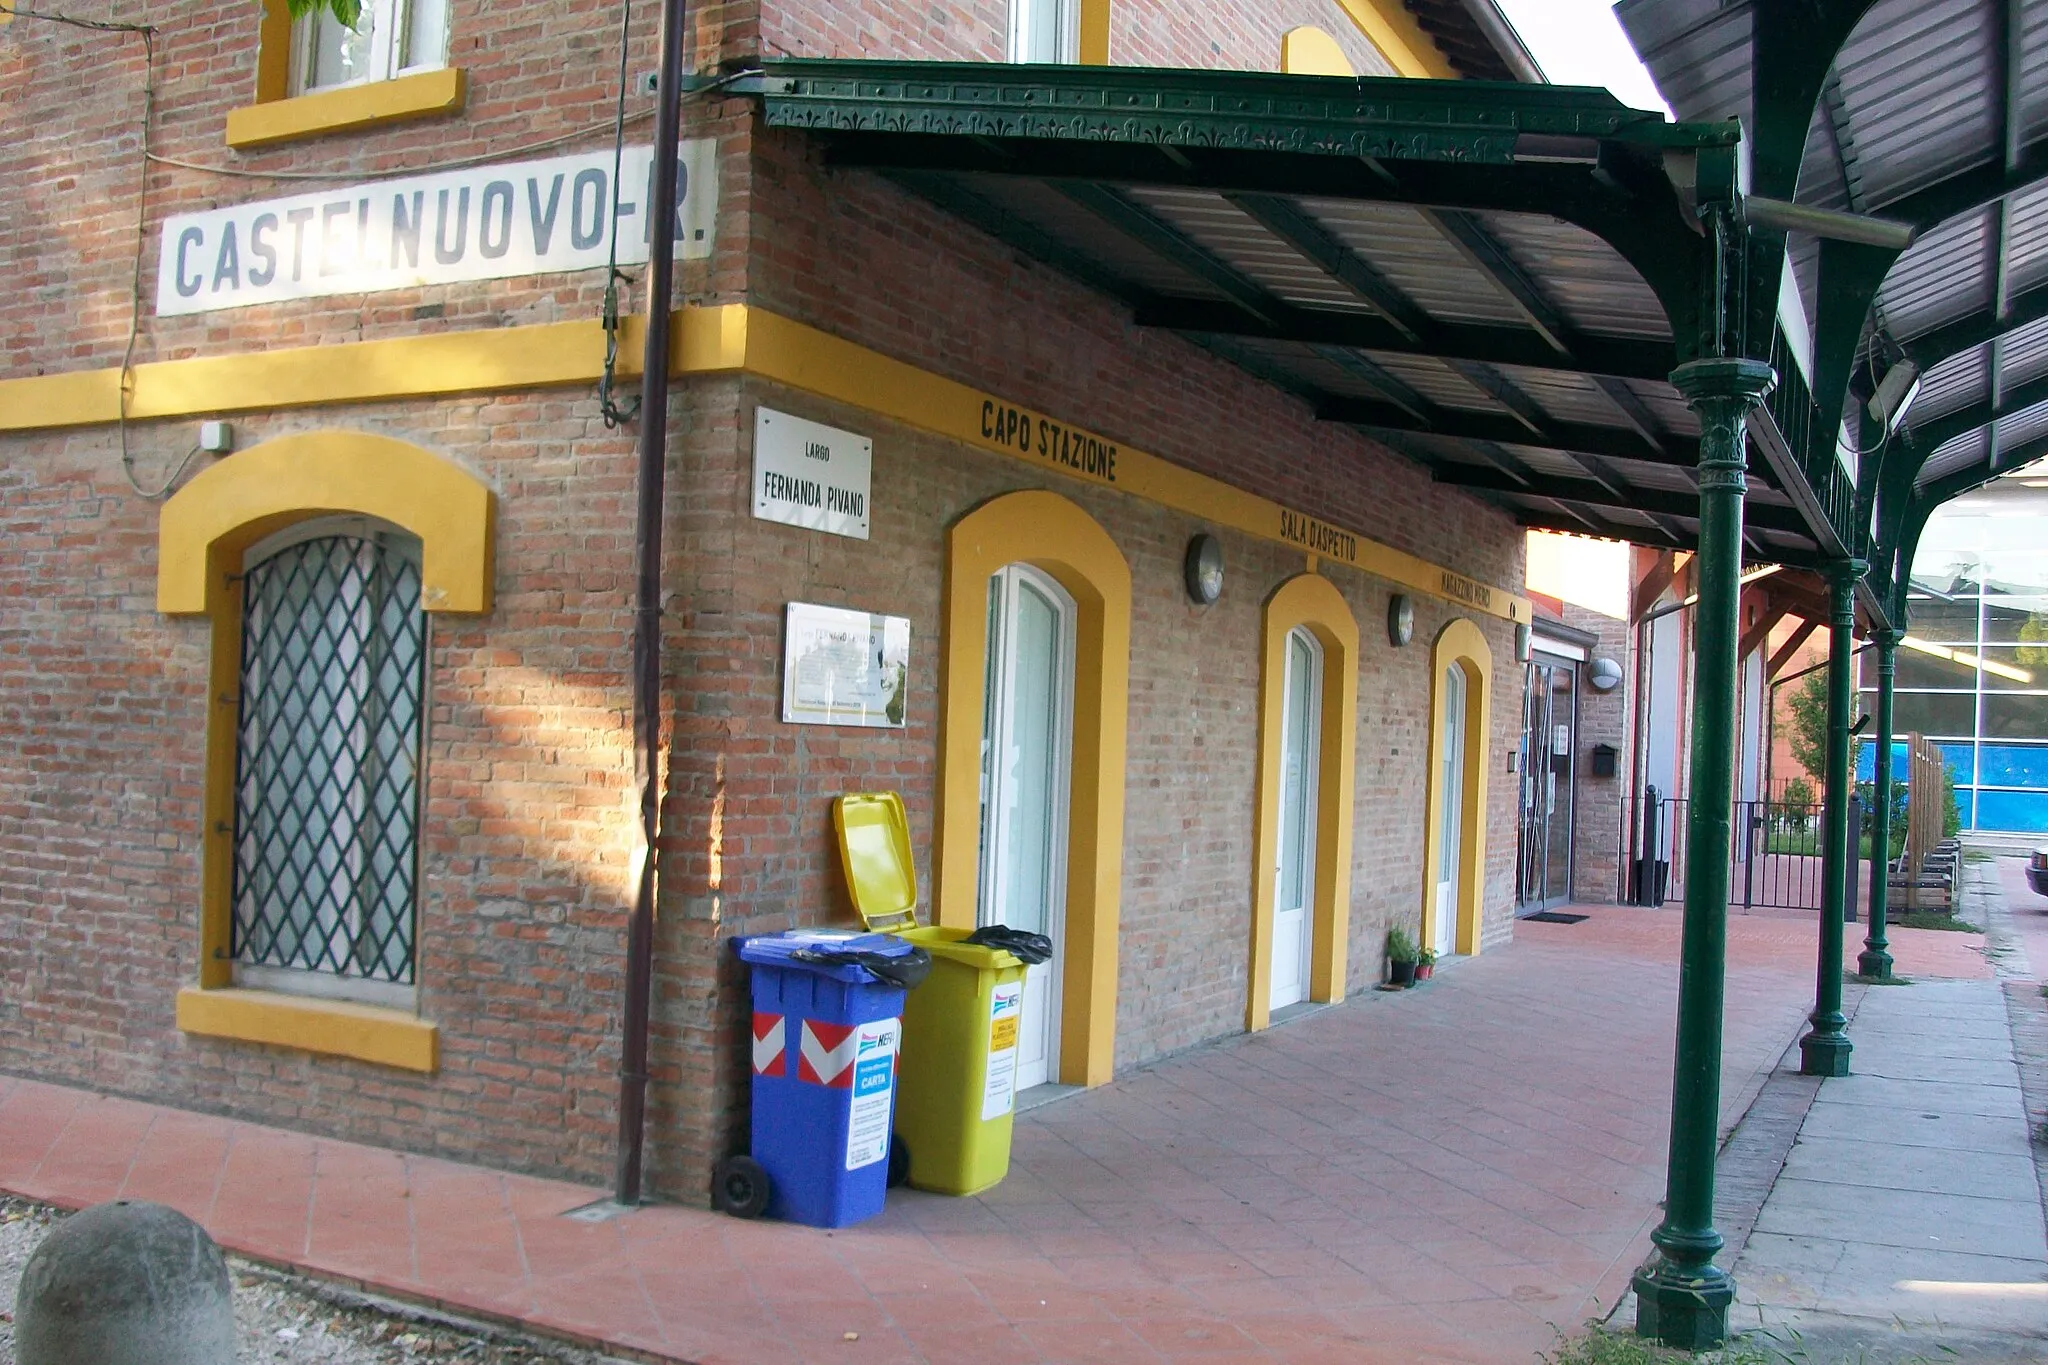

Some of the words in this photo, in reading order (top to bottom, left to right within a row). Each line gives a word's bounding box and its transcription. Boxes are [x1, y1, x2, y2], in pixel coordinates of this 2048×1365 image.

[805, 442, 830, 462] LARGO
[981, 400, 1030, 452] CAPO
[1038, 419, 1117, 482] STAZIONE
[764, 471, 821, 508] FERNANDA
[827, 487, 864, 518] PIVANO
[1280, 510, 1306, 544] SALA
[861, 1073, 886, 1089] CARTA
